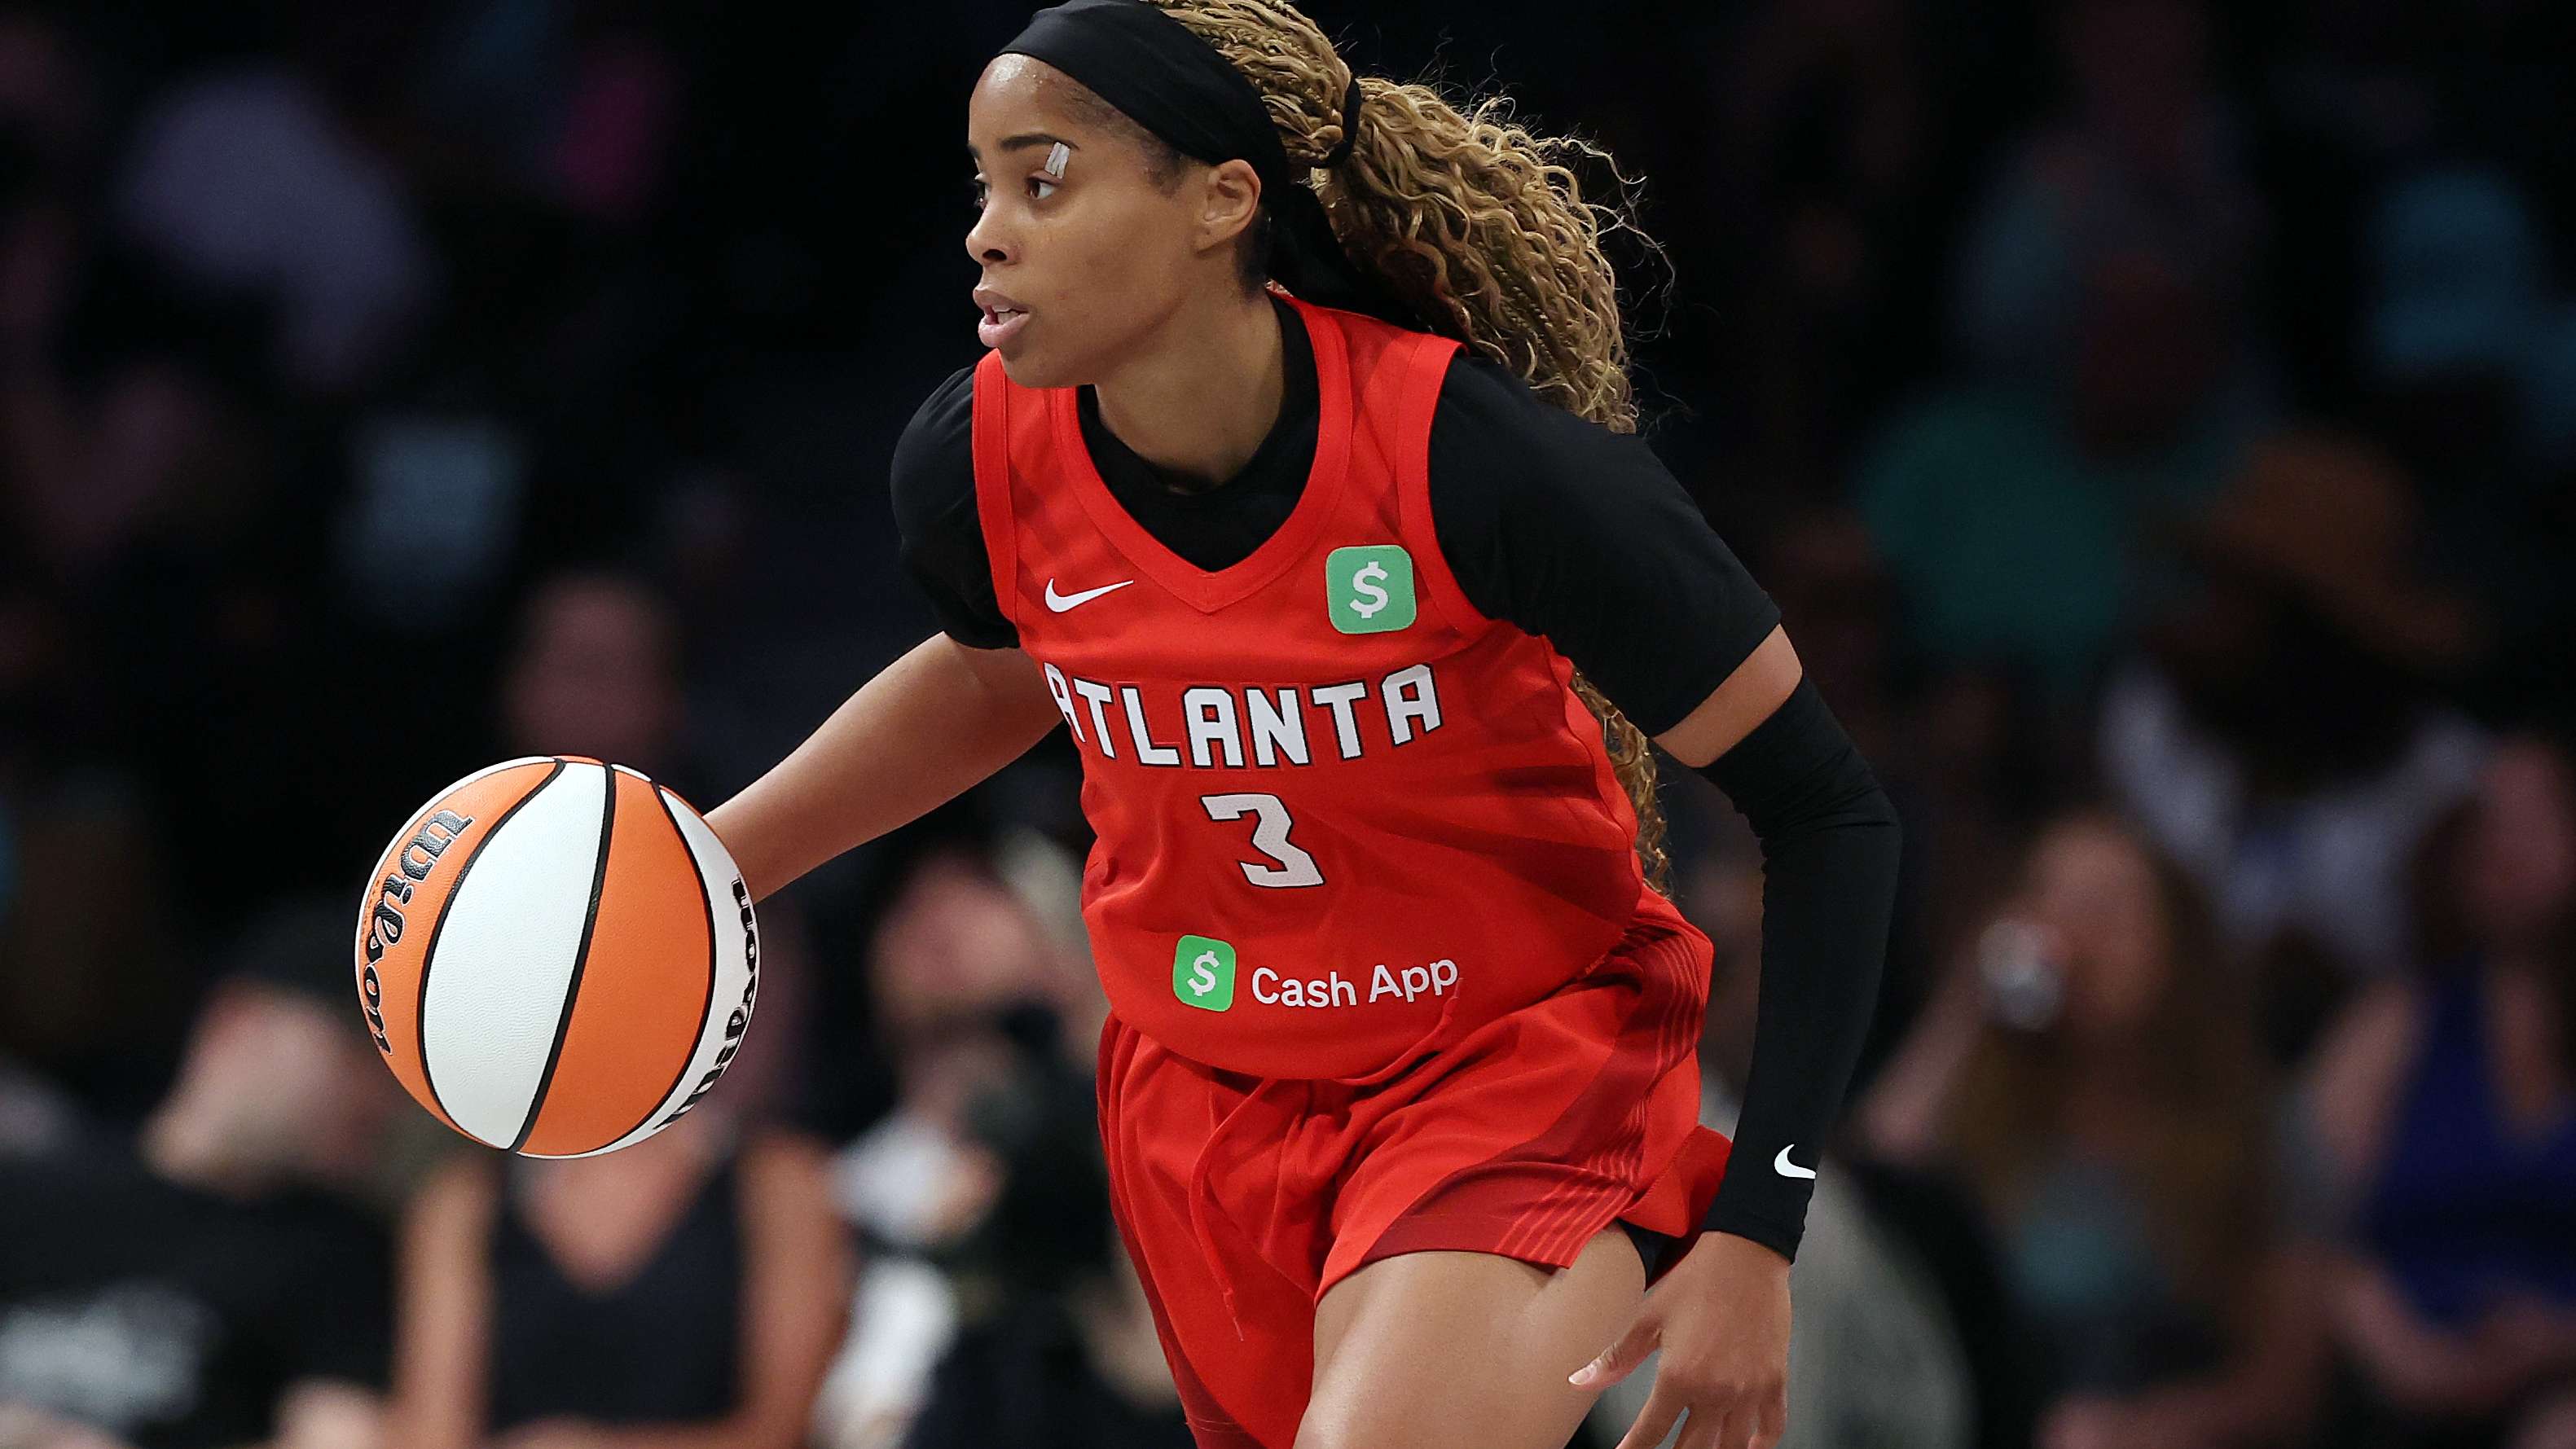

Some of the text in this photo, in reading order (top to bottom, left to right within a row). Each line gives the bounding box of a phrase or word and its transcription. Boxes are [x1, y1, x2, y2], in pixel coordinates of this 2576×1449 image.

[1043, 661, 1443, 767] ATLANTA
[1201, 793, 1325, 889] 3
[363, 809, 476, 1056] Wilson
[1251, 967, 1357, 1008] Cash
[1368, 958, 1458, 1003] App
